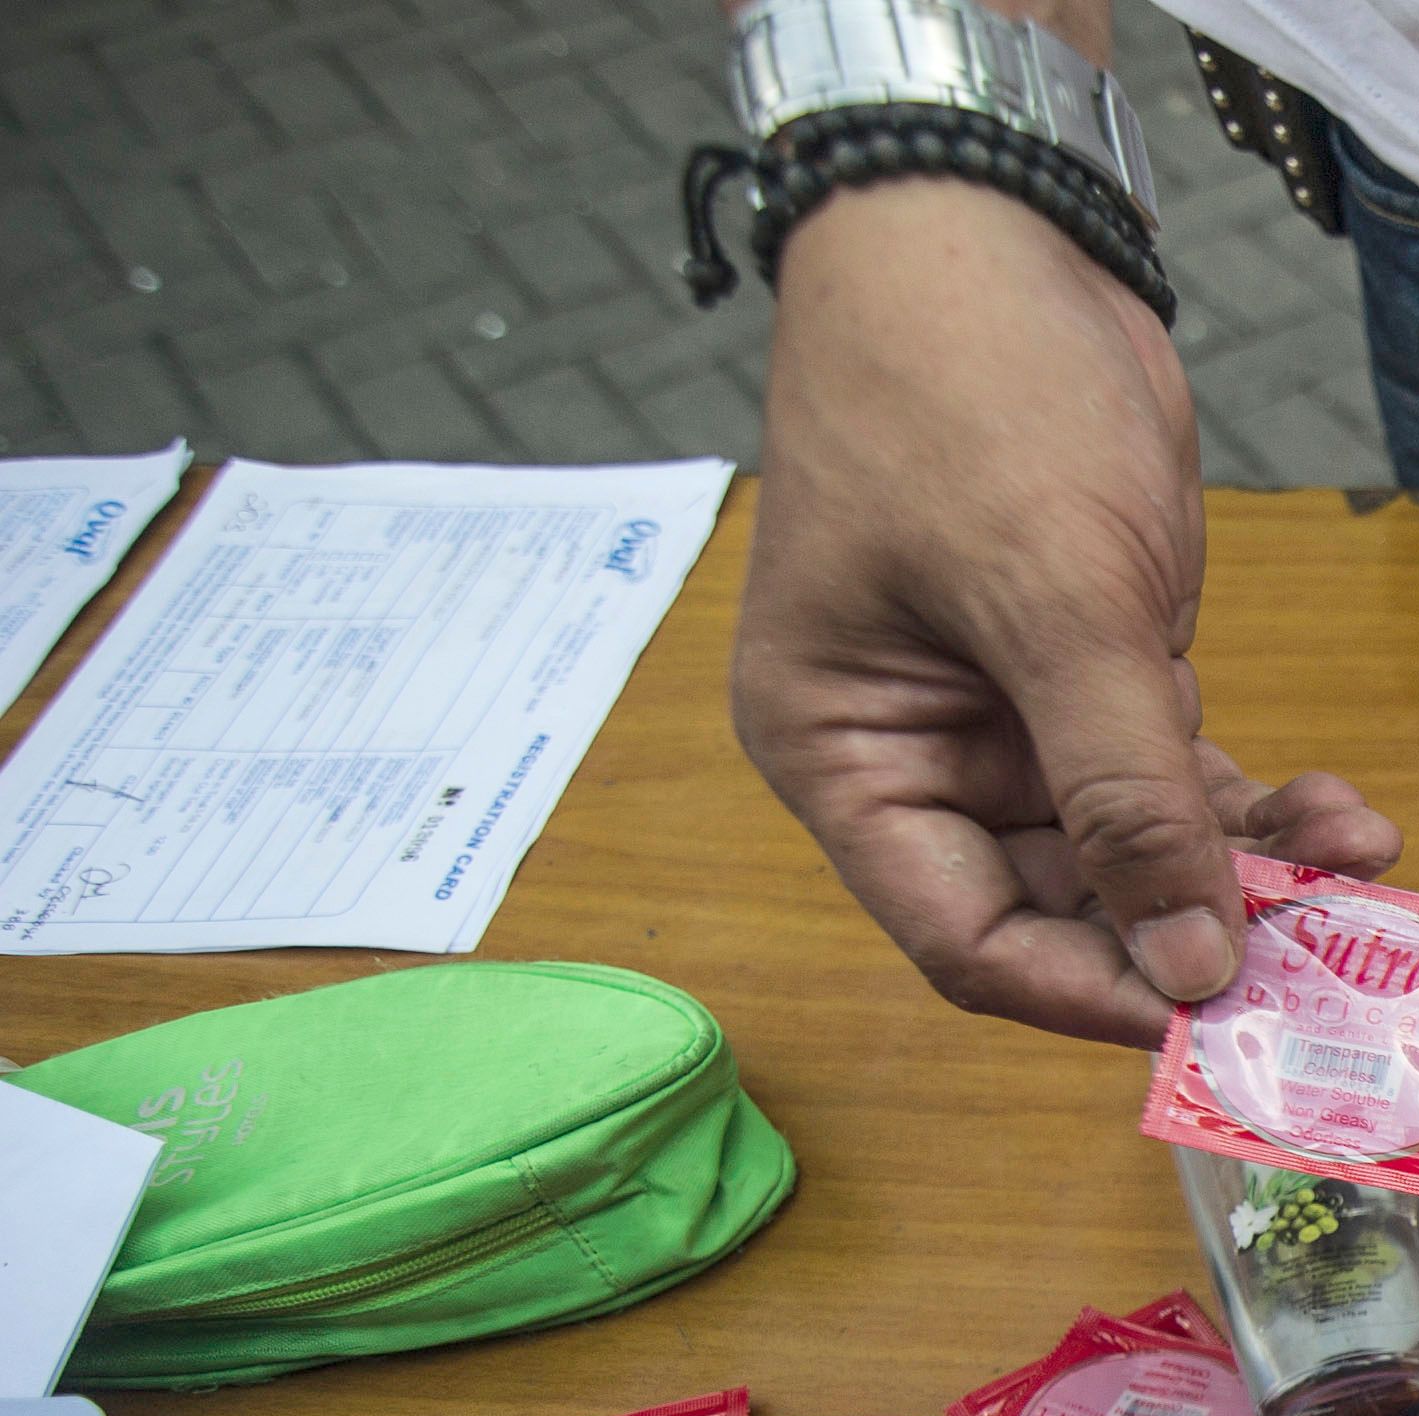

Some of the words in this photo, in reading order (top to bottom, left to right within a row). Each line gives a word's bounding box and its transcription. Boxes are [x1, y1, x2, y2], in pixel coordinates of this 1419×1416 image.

[466, 734, 550, 851] REGISTRATION
[434, 854, 474, 901] CARD
[1300, 1039, 1392, 1066] Transparent
[1281, 1080, 1325, 1100] Water
[1330, 1085, 1390, 1109] Soluble
[1282, 1102, 1314, 1120] Non
[1319, 1109, 1378, 1133] Greasy
